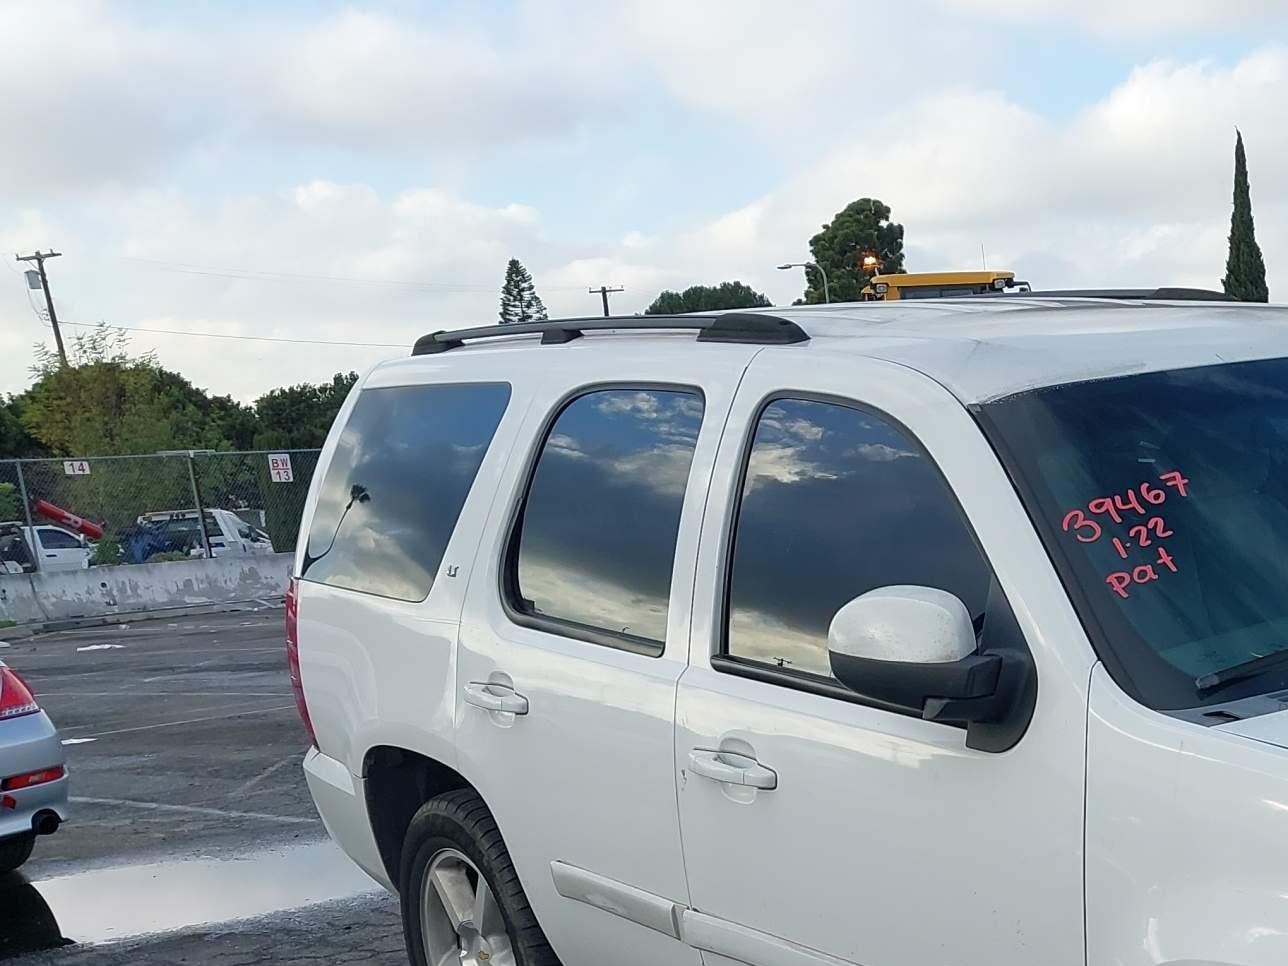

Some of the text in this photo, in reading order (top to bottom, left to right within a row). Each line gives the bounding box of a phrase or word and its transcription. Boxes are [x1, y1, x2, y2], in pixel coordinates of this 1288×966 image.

[69, 462, 86, 473] 14
[271, 458, 289, 468] BW
[275, 470, 290, 481] 13
[1062, 471, 1189, 542] 39467
